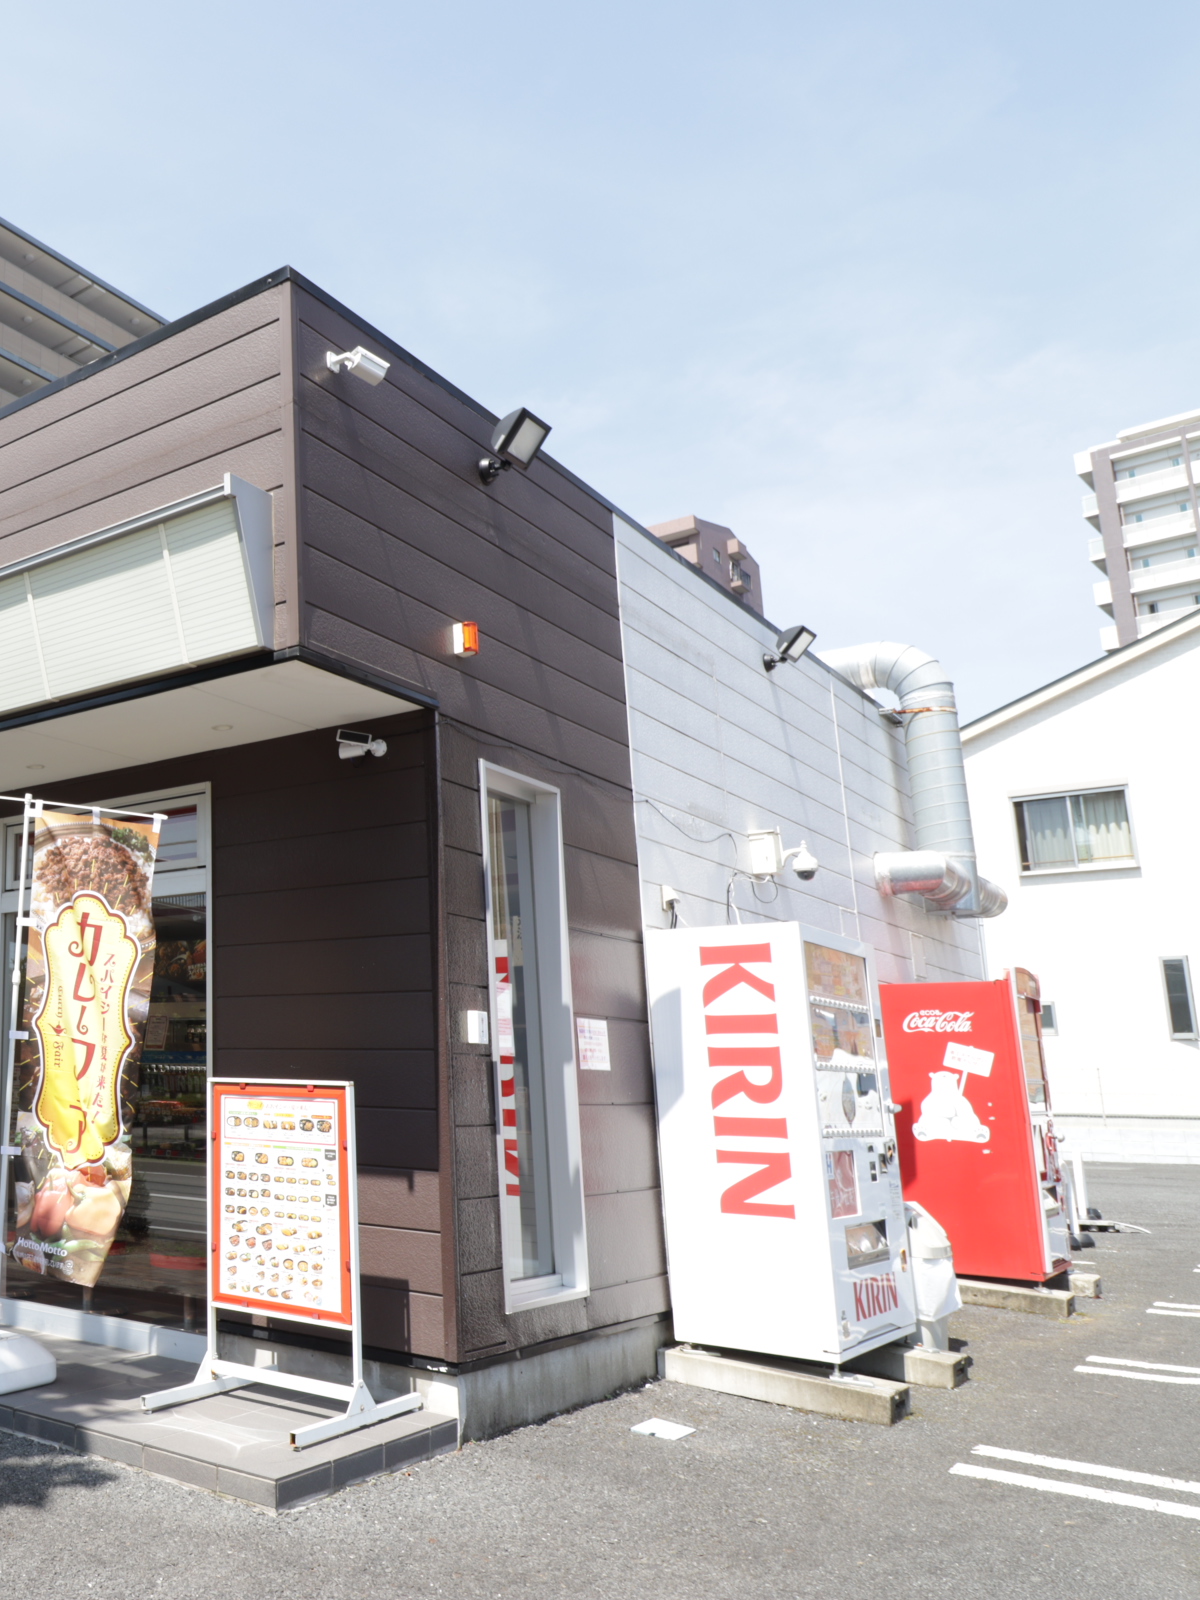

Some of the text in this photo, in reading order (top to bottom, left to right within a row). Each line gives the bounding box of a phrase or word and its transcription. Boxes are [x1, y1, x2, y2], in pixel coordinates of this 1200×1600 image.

[902, 1011, 975, 1033] Coca-Cola
[699, 942, 796, 1219] KIRIN
[16, 1236, 68, 1257] HottoMotto
[853, 1271, 899, 1322] KIRIN
